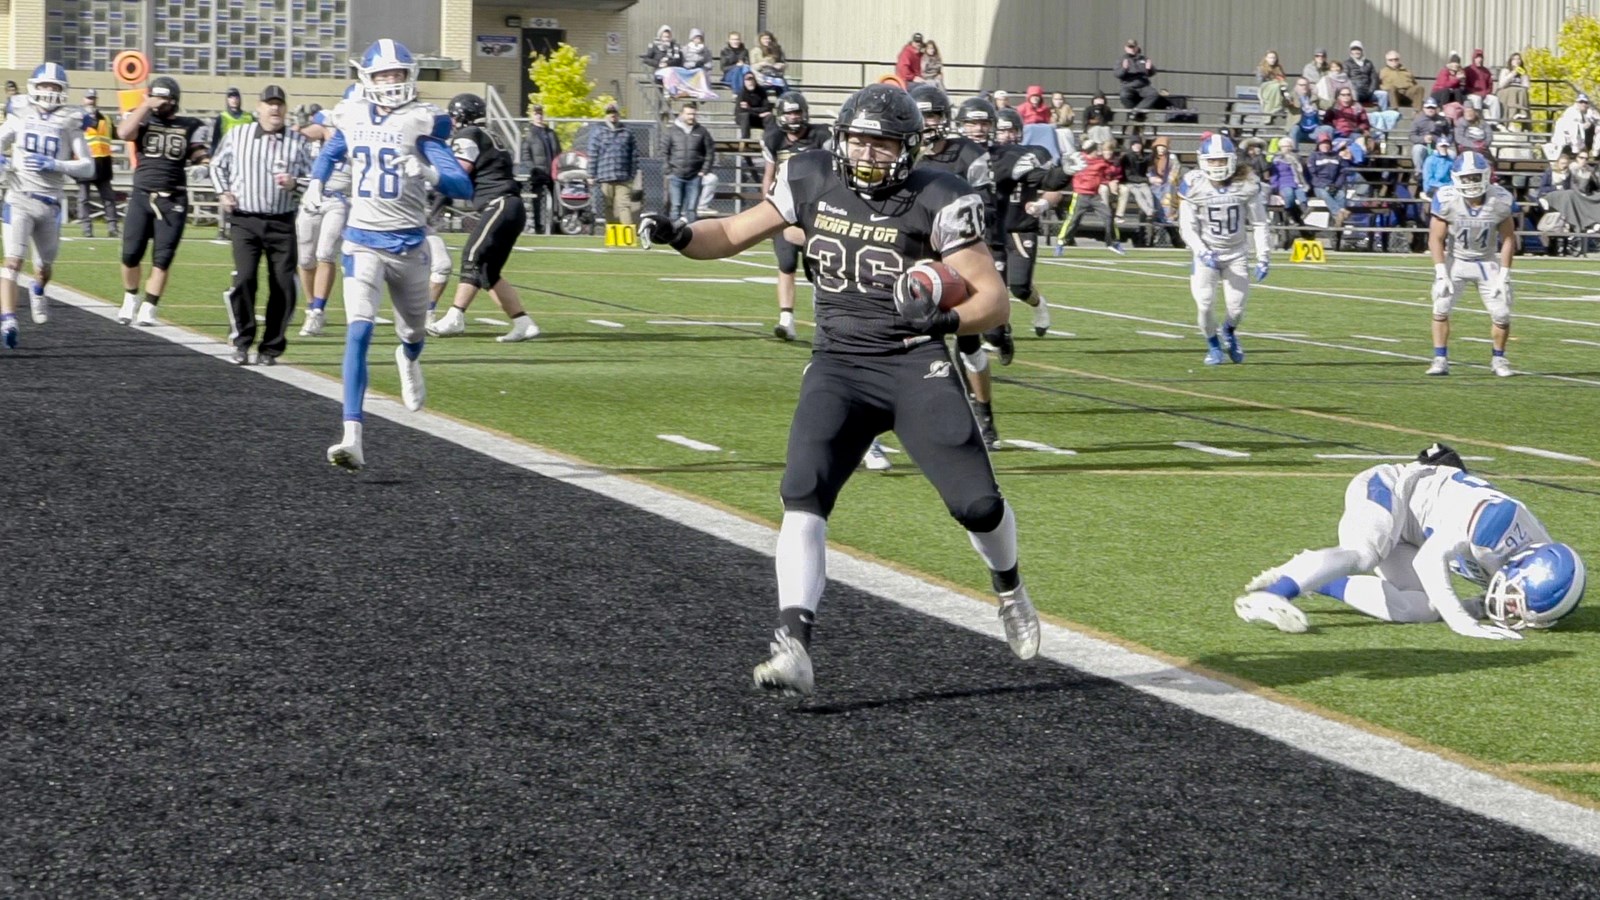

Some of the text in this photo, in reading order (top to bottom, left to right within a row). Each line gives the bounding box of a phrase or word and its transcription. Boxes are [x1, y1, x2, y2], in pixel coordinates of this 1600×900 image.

[142, 131, 187, 160] 98
[352, 145, 400, 199] 28
[1208, 205, 1239, 235] 50
[611, 225, 635, 246] 10
[806, 234, 903, 293] 36
[1302, 243, 1322, 261] 20
